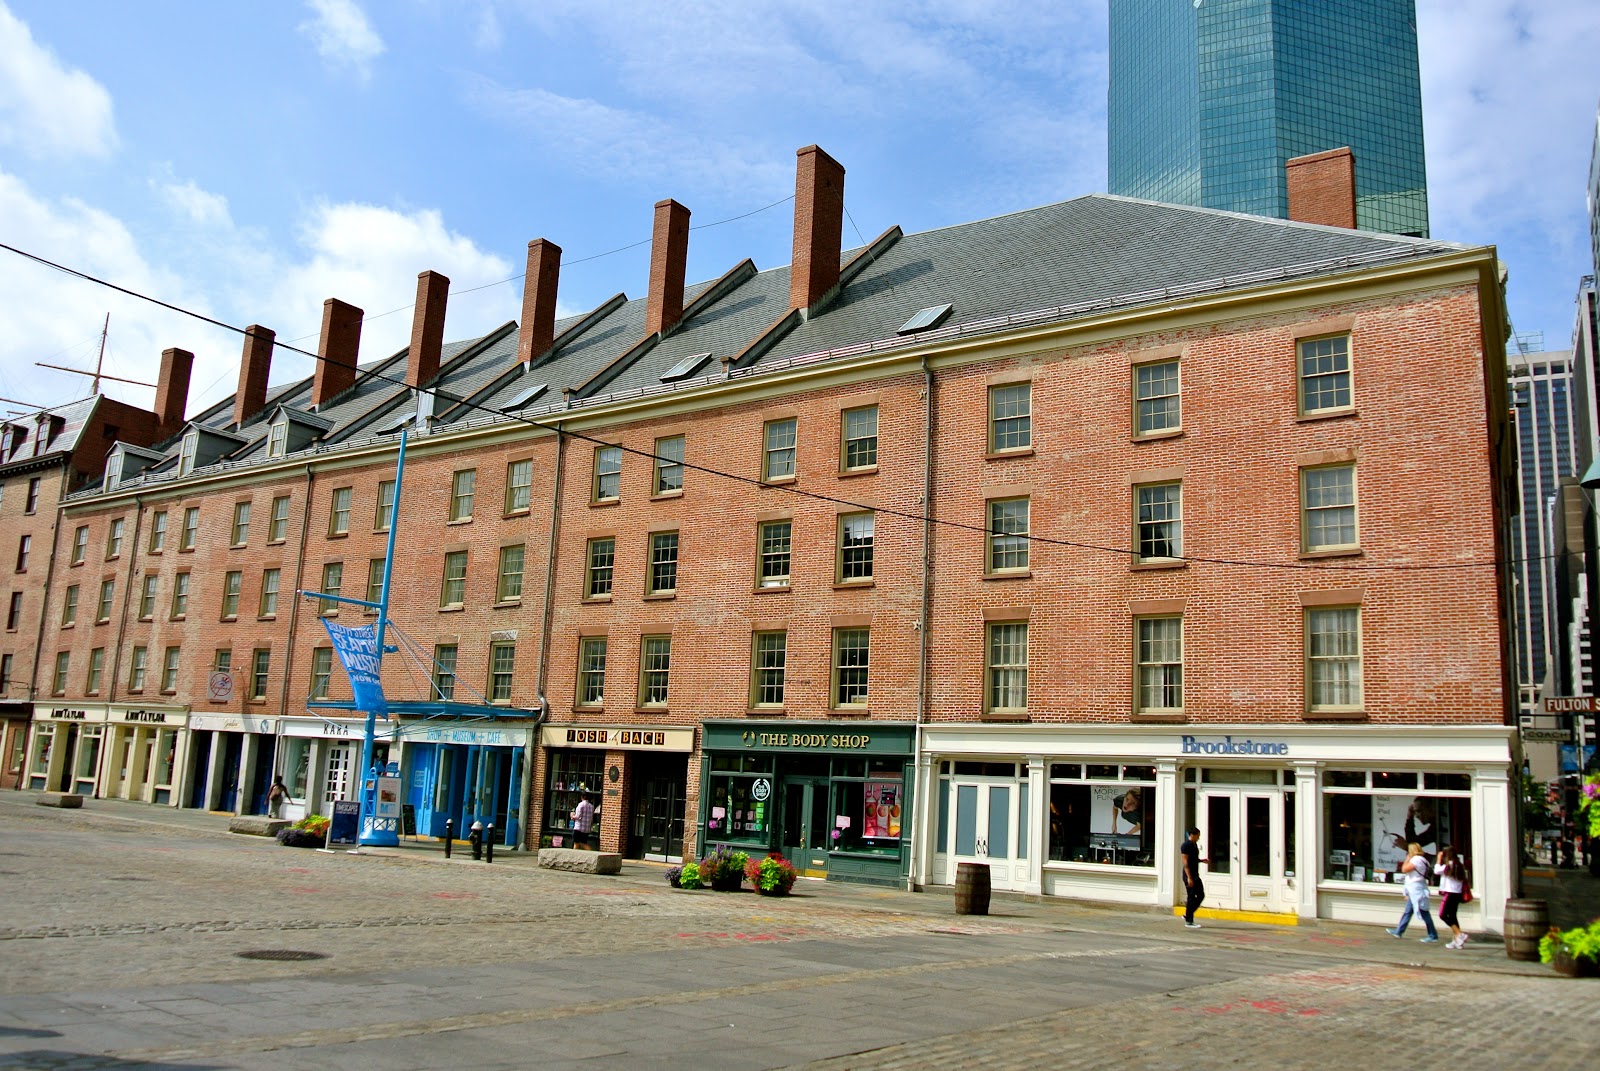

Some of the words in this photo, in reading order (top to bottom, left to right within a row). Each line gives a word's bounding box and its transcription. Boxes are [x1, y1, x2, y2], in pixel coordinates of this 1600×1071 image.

[353, 675, 372, 683] NOW
[1547, 698, 1590, 711] FULTON
[323, 723, 349, 736] KARA
[427, 729, 442, 740] SHOP
[453, 730, 476, 742] MUSEUM
[487, 730, 502, 743] CAFÉ
[568, 730, 607, 742] JOSH
[622, 732, 664, 744] BACH
[760, 733, 788, 746] THE
[791, 734, 829, 747] BODY
[831, 735, 870, 748] SHOP
[1181, 735, 1289, 755] Brookstone
